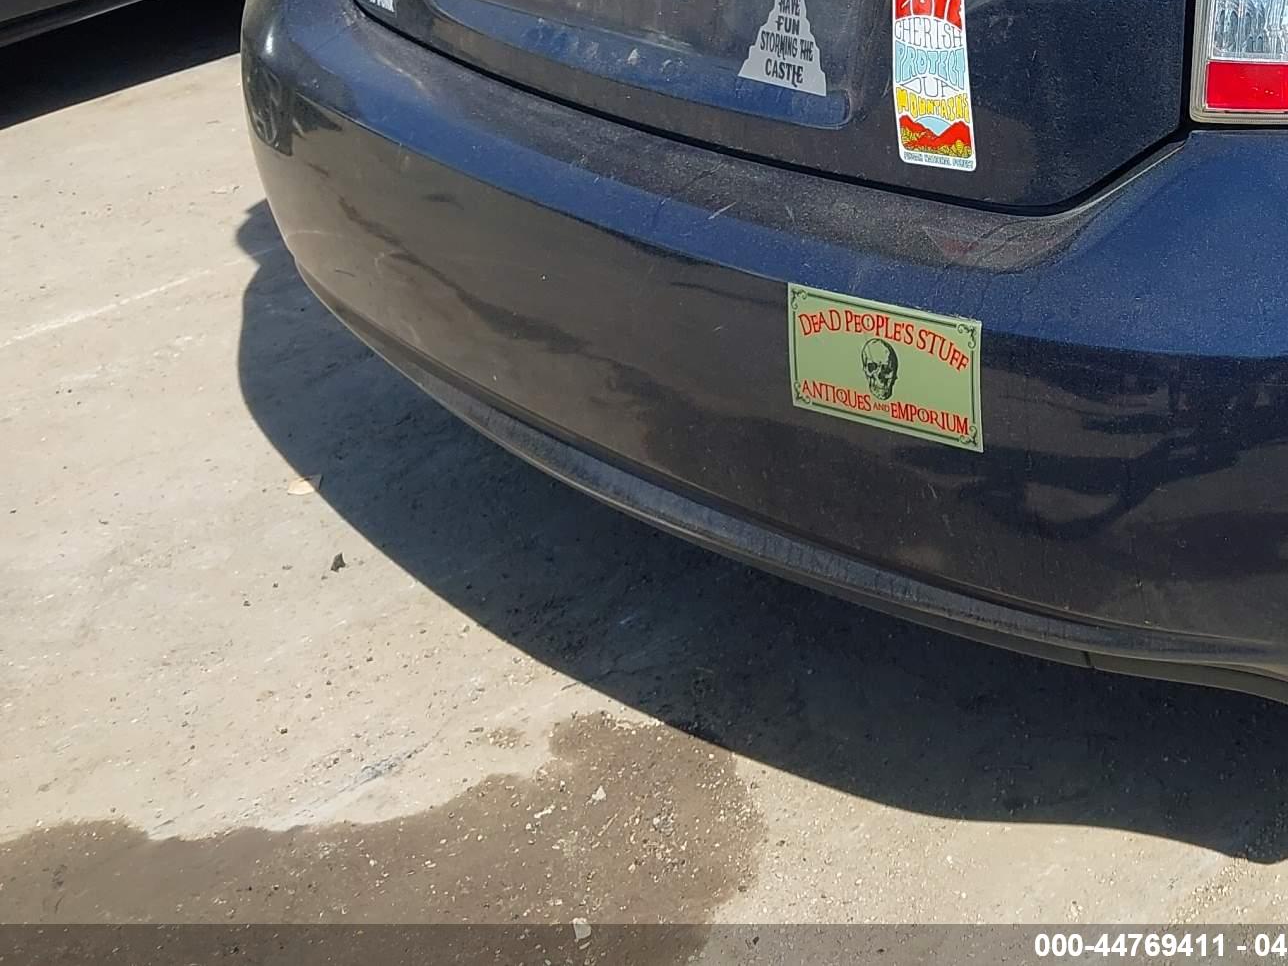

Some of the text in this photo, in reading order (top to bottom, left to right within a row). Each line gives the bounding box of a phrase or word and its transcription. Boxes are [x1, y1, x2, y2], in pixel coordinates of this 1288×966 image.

[775, 15, 800, 35] FUN
[895, 17, 963, 49] CHERISH
[760, 30, 814, 62] STORMING THE
[765, 58, 803, 87] CASTLE
[895, 40, 965, 90] PROTECT
[896, 86, 970, 123] MOUNTAINS
[798, 309, 970, 372] DEAD PEOPLE'S STUFF
[801, 380, 970, 436] ANTIQUES AND EMPORIUM
